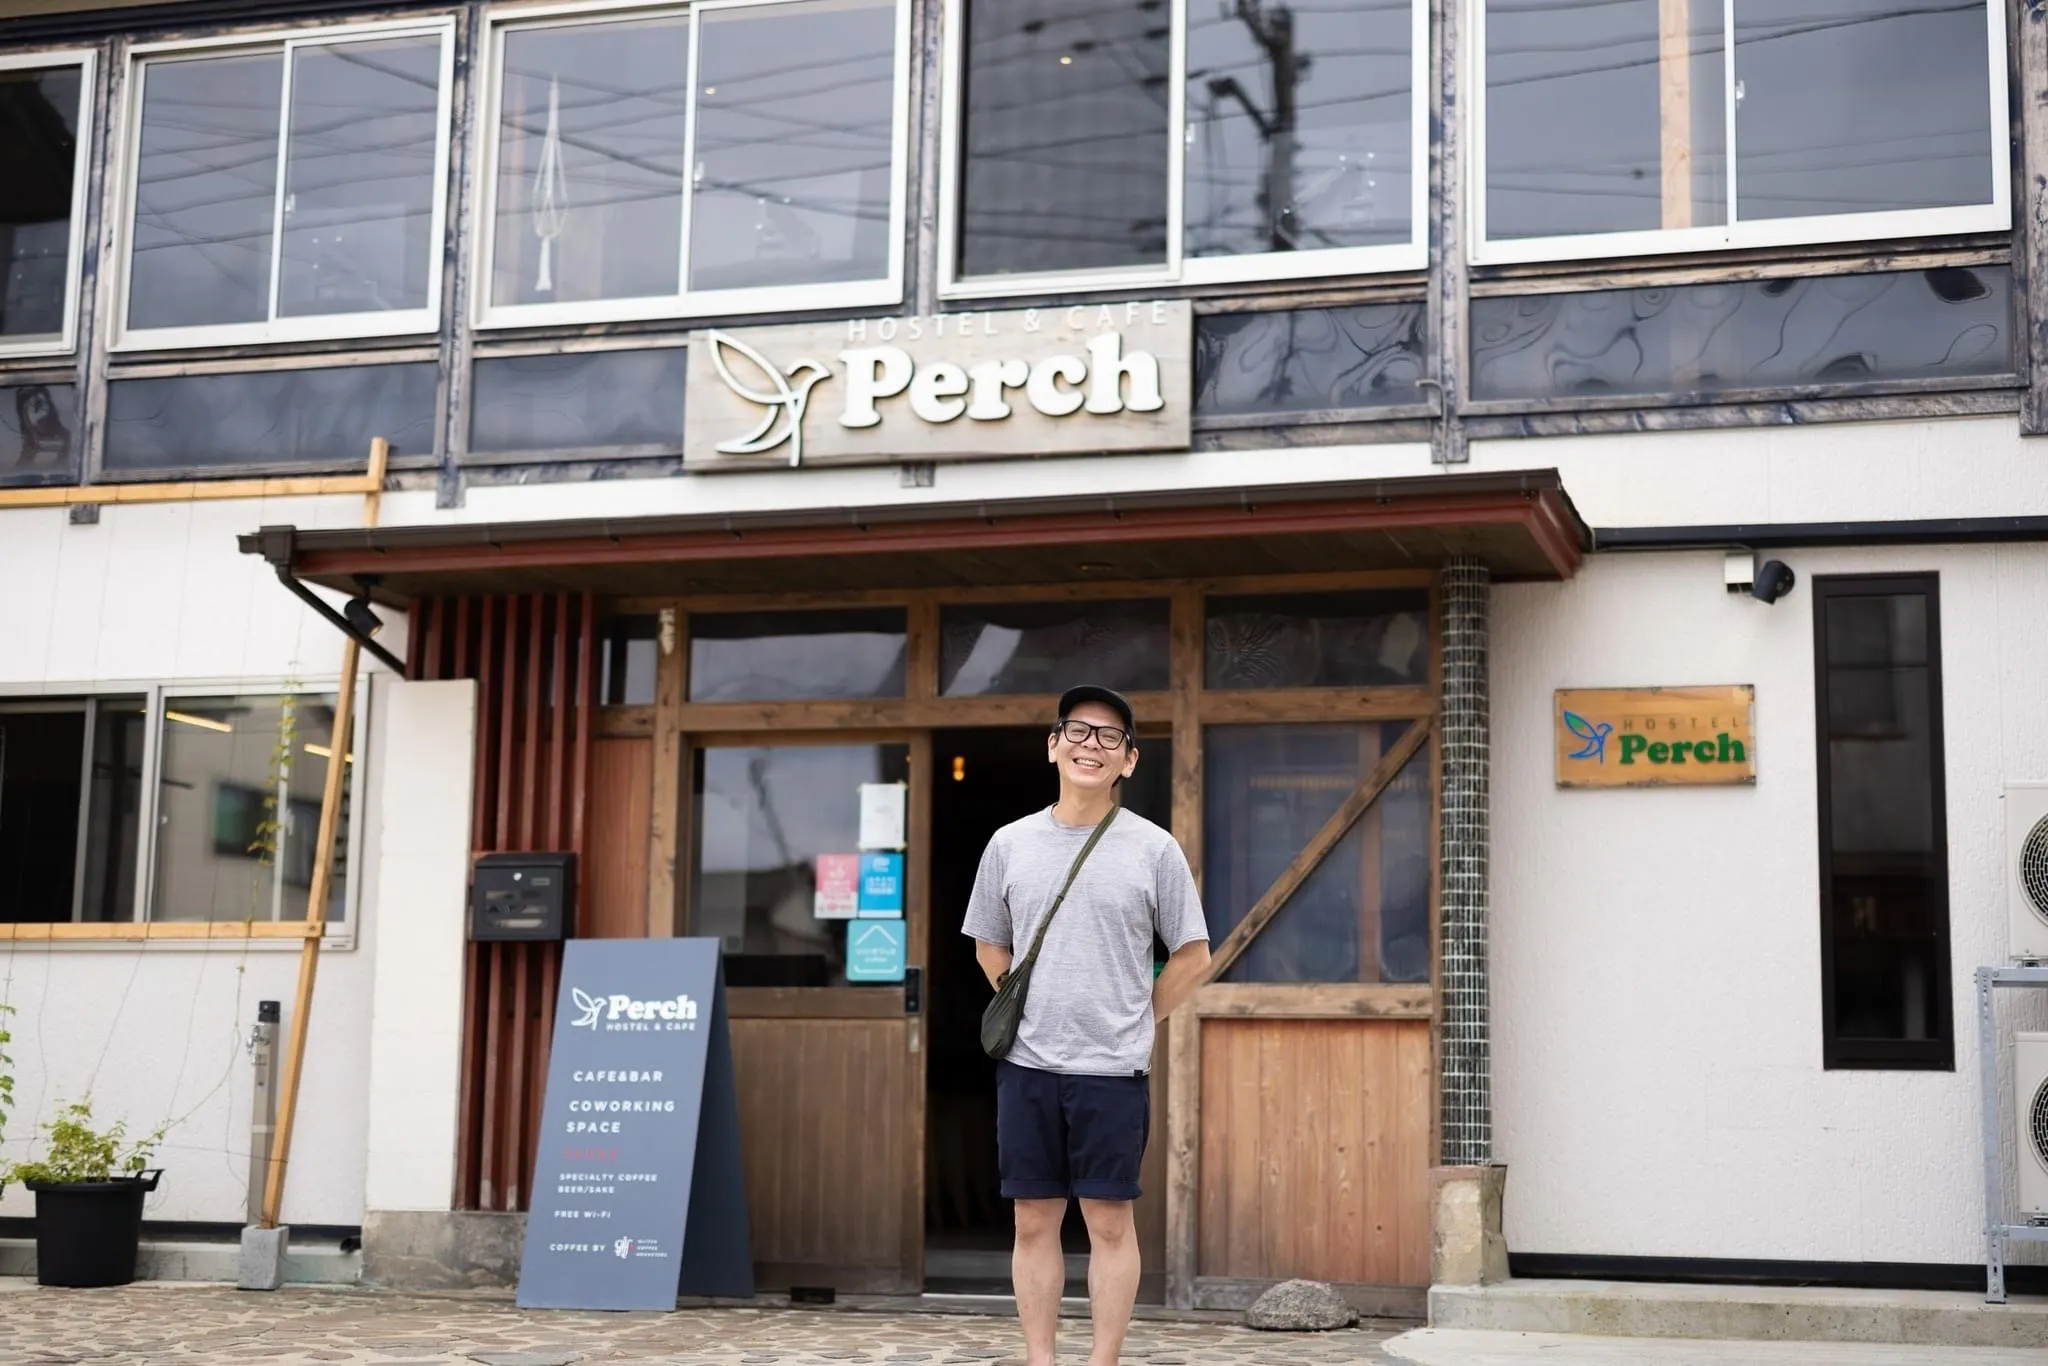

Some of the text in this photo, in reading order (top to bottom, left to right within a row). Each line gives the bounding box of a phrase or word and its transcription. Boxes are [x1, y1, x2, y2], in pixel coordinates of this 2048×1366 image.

[848, 301, 1168, 342] HOSTEL & CAFE
[838, 332, 1165, 429] Perch
[1623, 718, 1739, 730] HOSTEL
[1618, 732, 1747, 766] Perch
[606, 994, 698, 1020] Perch
[606, 1022, 649, 1032] HOSTEL
[666, 1022, 696, 1031] CAFE
[573, 1070, 663, 1082] CAFE&BAR
[569, 1100, 675, 1112] COWORKING
[566, 1121, 621, 1133] SPACE
[559, 1173, 658, 1182] SPECIALTY COFFEE
[557, 1186, 615, 1194] BEER/SAKE
[554, 1210, 580, 1219] FREE
[549, 1243, 606, 1252] COFFEE BY
